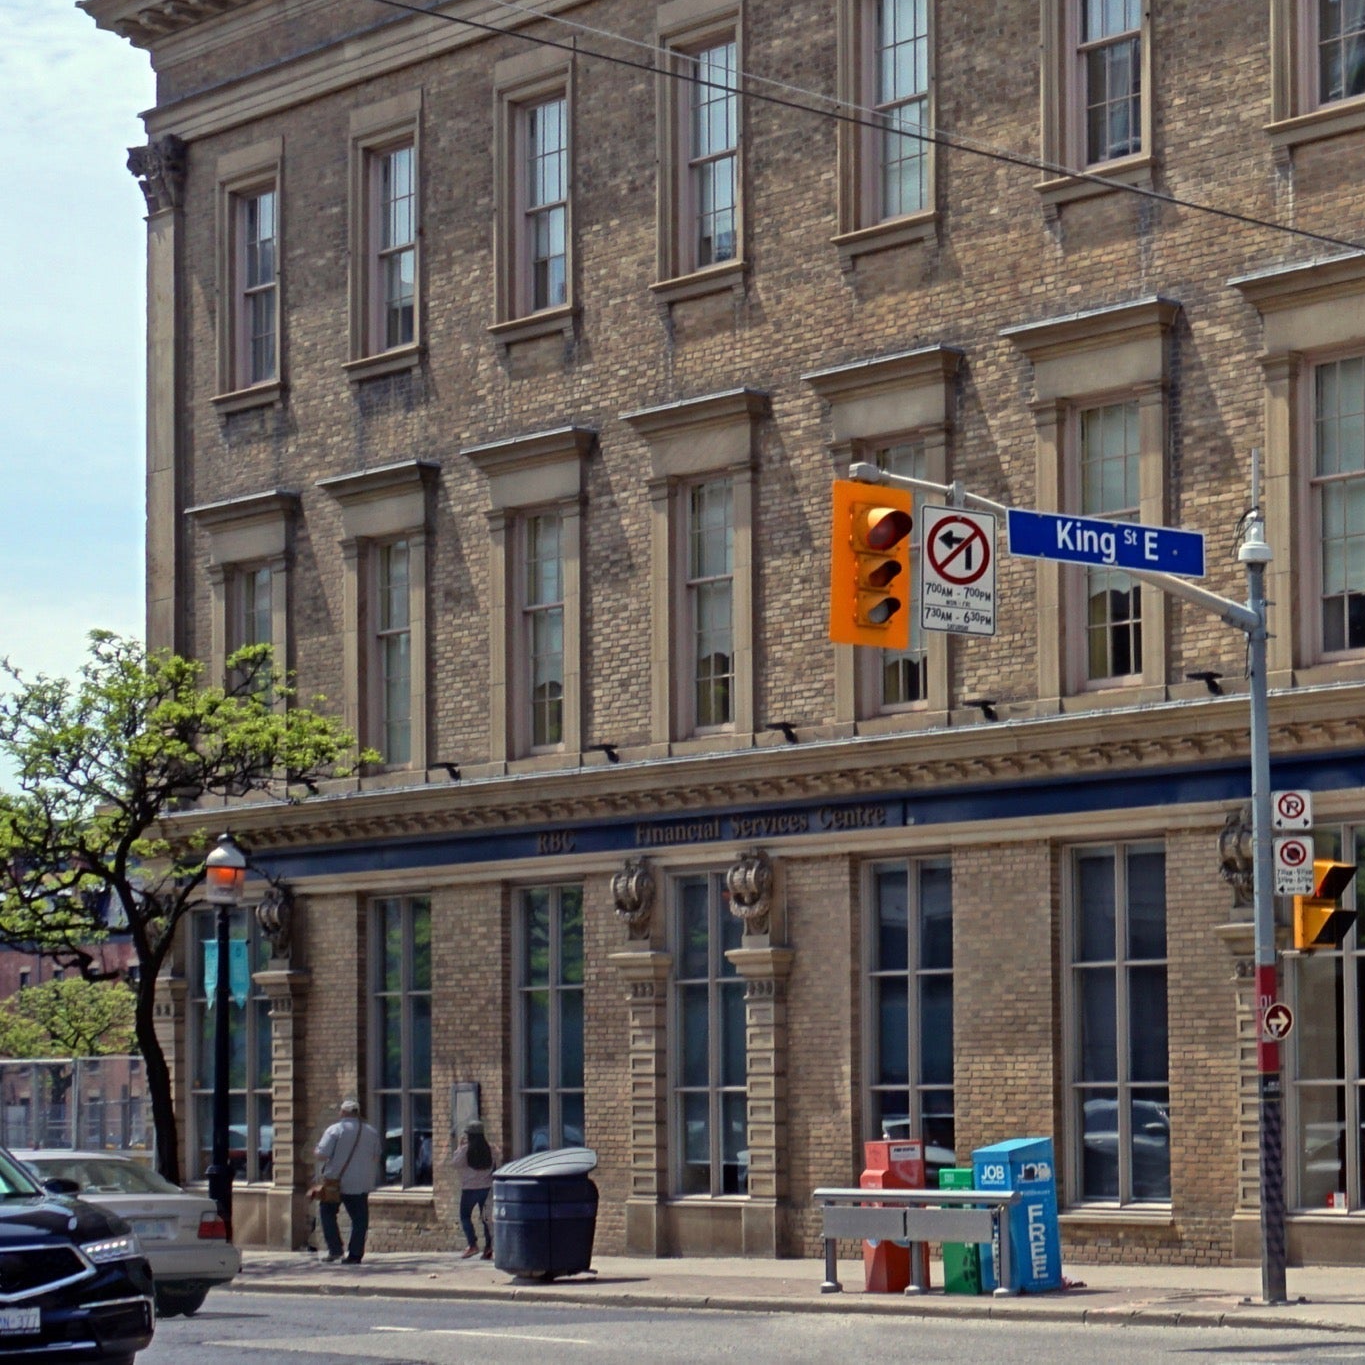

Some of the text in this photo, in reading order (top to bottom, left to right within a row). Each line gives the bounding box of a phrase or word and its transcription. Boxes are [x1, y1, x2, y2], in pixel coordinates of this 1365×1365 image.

[1056, 520, 1159, 563] King St E
[536, 802, 887, 854] RBC Financial Services Centre
[981, 1164, 1005, 1180] JOB
[1027, 1203, 1049, 1280] FREE
